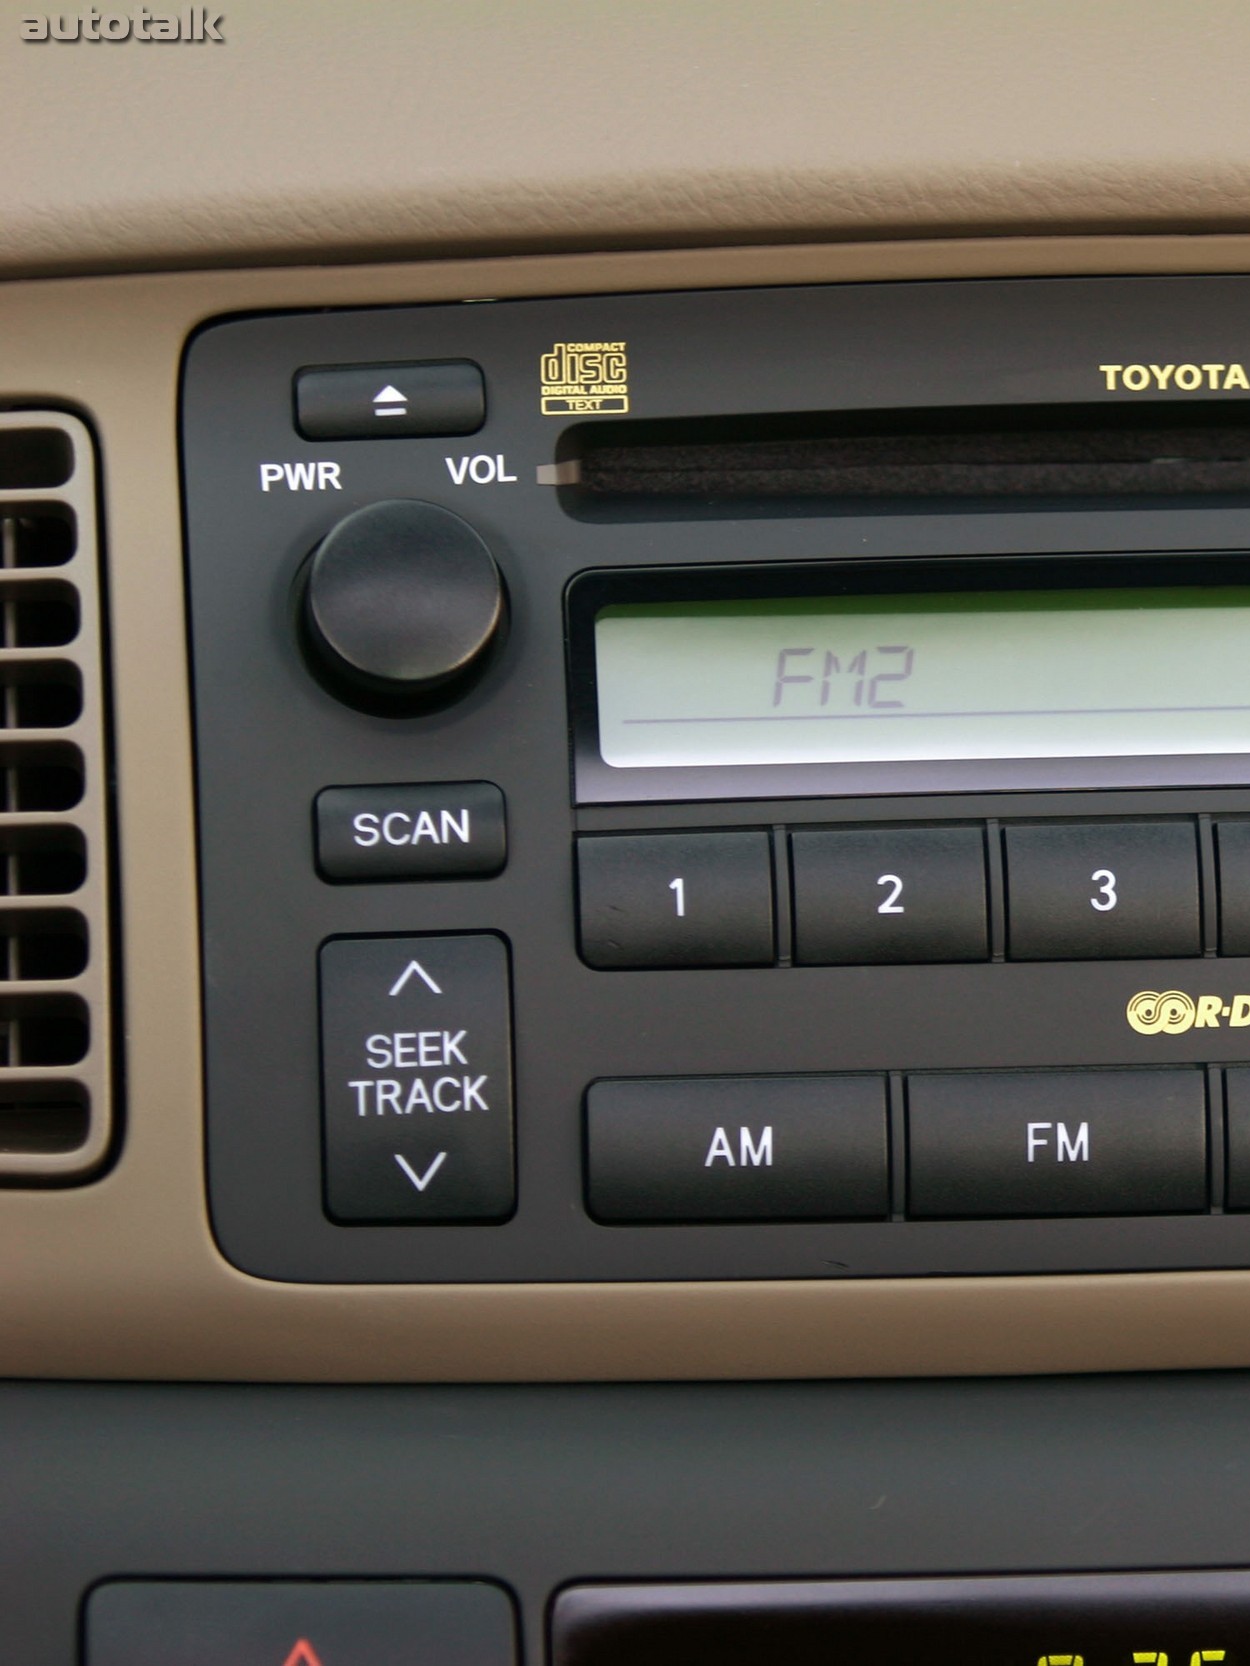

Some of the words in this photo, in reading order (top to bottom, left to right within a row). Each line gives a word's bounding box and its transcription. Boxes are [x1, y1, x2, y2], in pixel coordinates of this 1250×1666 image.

[567, 342, 626, 353] COMPACT
[541, 385, 588, 396] DIGITAL
[589, 384, 627, 395] AUDIO
[1099, 363, 1250, 391] TOYOTA
[565, 399, 604, 411] TEXT
[260, 461, 342, 492] PWR
[444, 454, 518, 485] VOL
[773, 645, 915, 708] FM2
[353, 808, 471, 848] SCAN
[669, 877, 685, 917] 1
[877, 874, 905, 914] 2
[1090, 869, 1118, 911] 3
[365, 1030, 469, 1069] SEEK
[348, 1075, 489, 1116] TRACK
[704, 1126, 774, 1168] AM
[1026, 1121, 1090, 1163] FM
